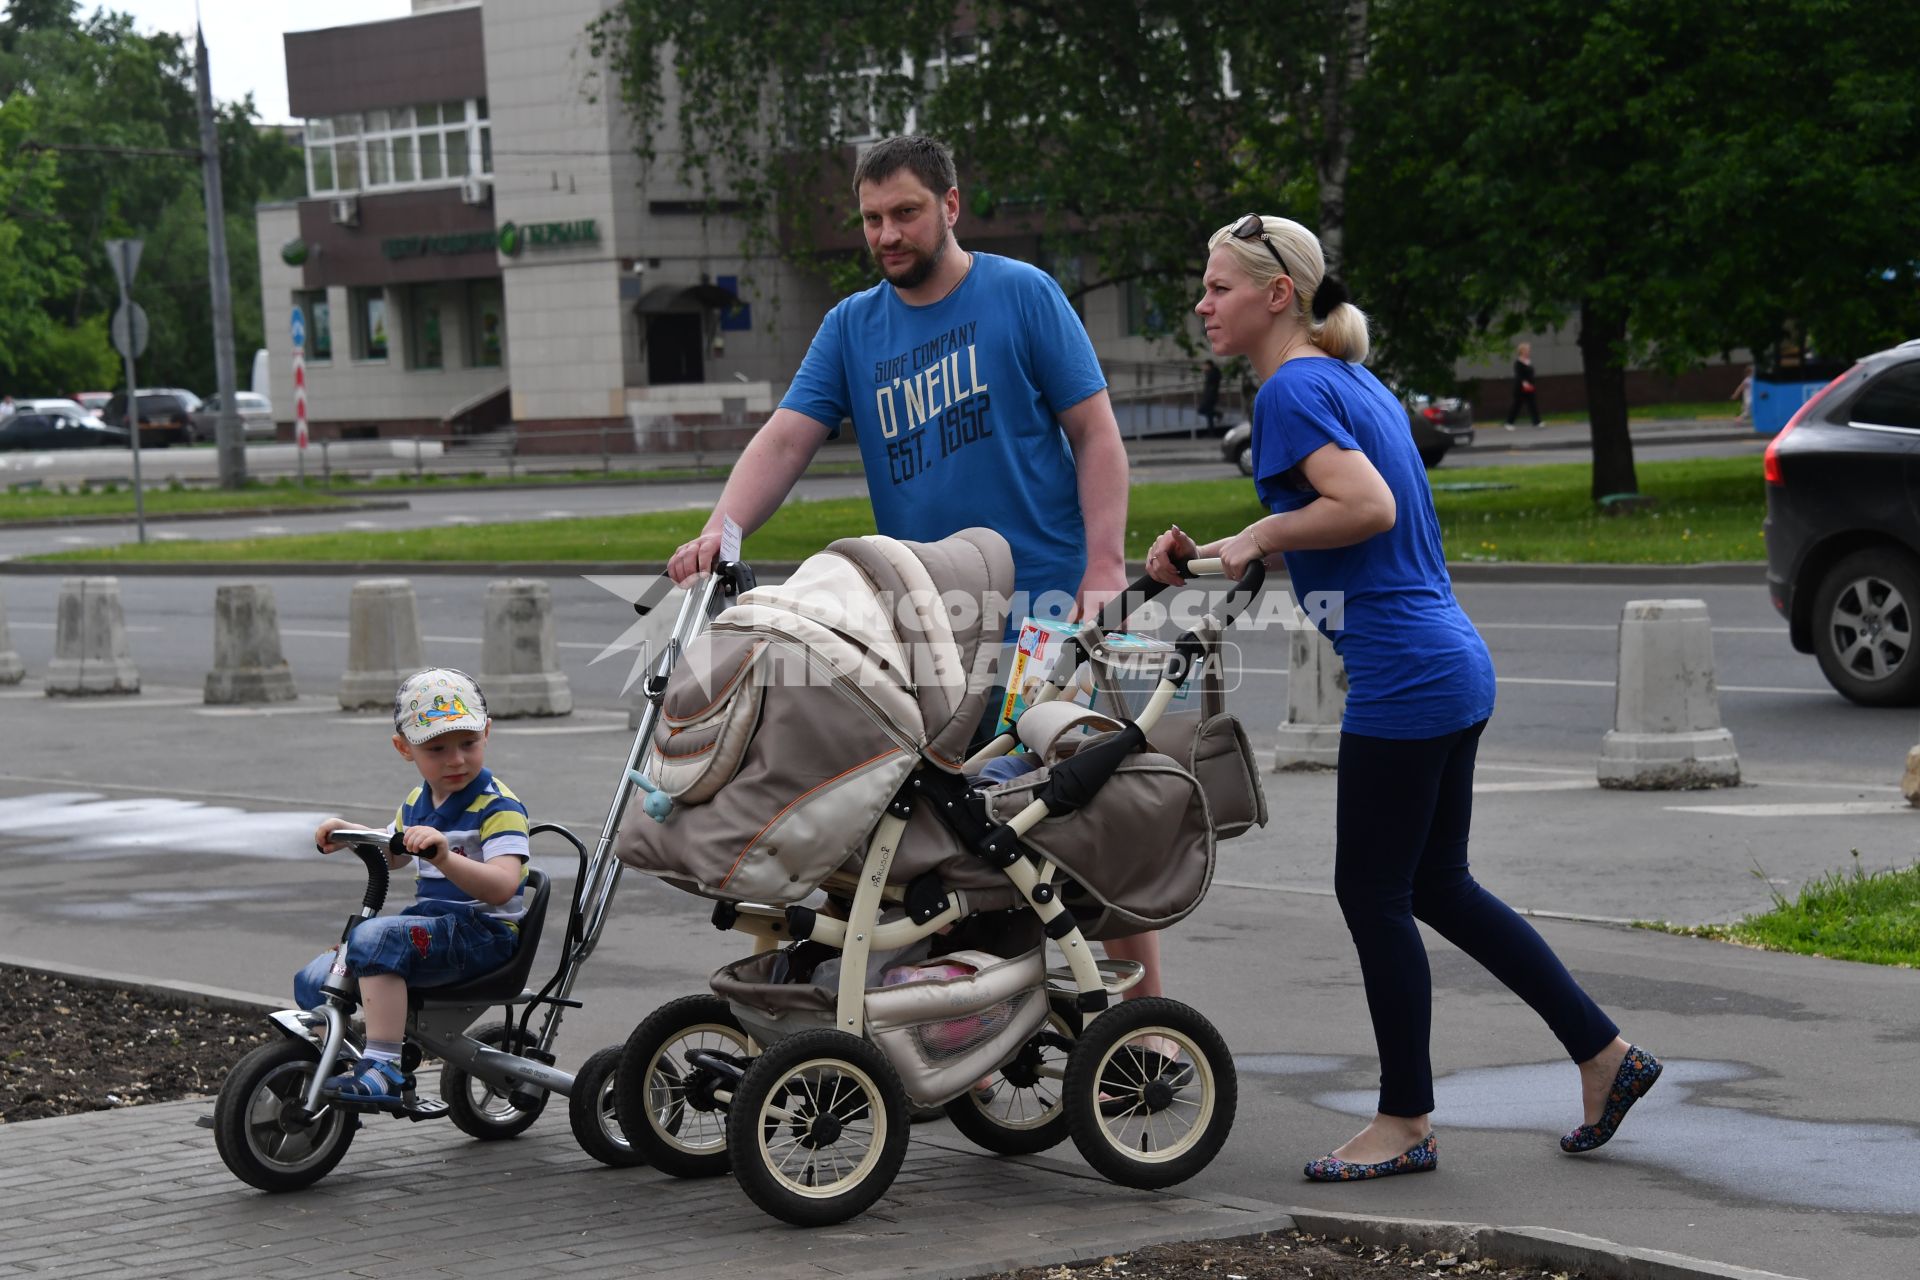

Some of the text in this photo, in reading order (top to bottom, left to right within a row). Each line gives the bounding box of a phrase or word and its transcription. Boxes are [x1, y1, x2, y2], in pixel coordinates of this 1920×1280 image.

[875, 321, 977, 383] SURF COMPANY
[876, 344, 988, 438] O'NEILL
[886, 394, 993, 485] EST. 1952
